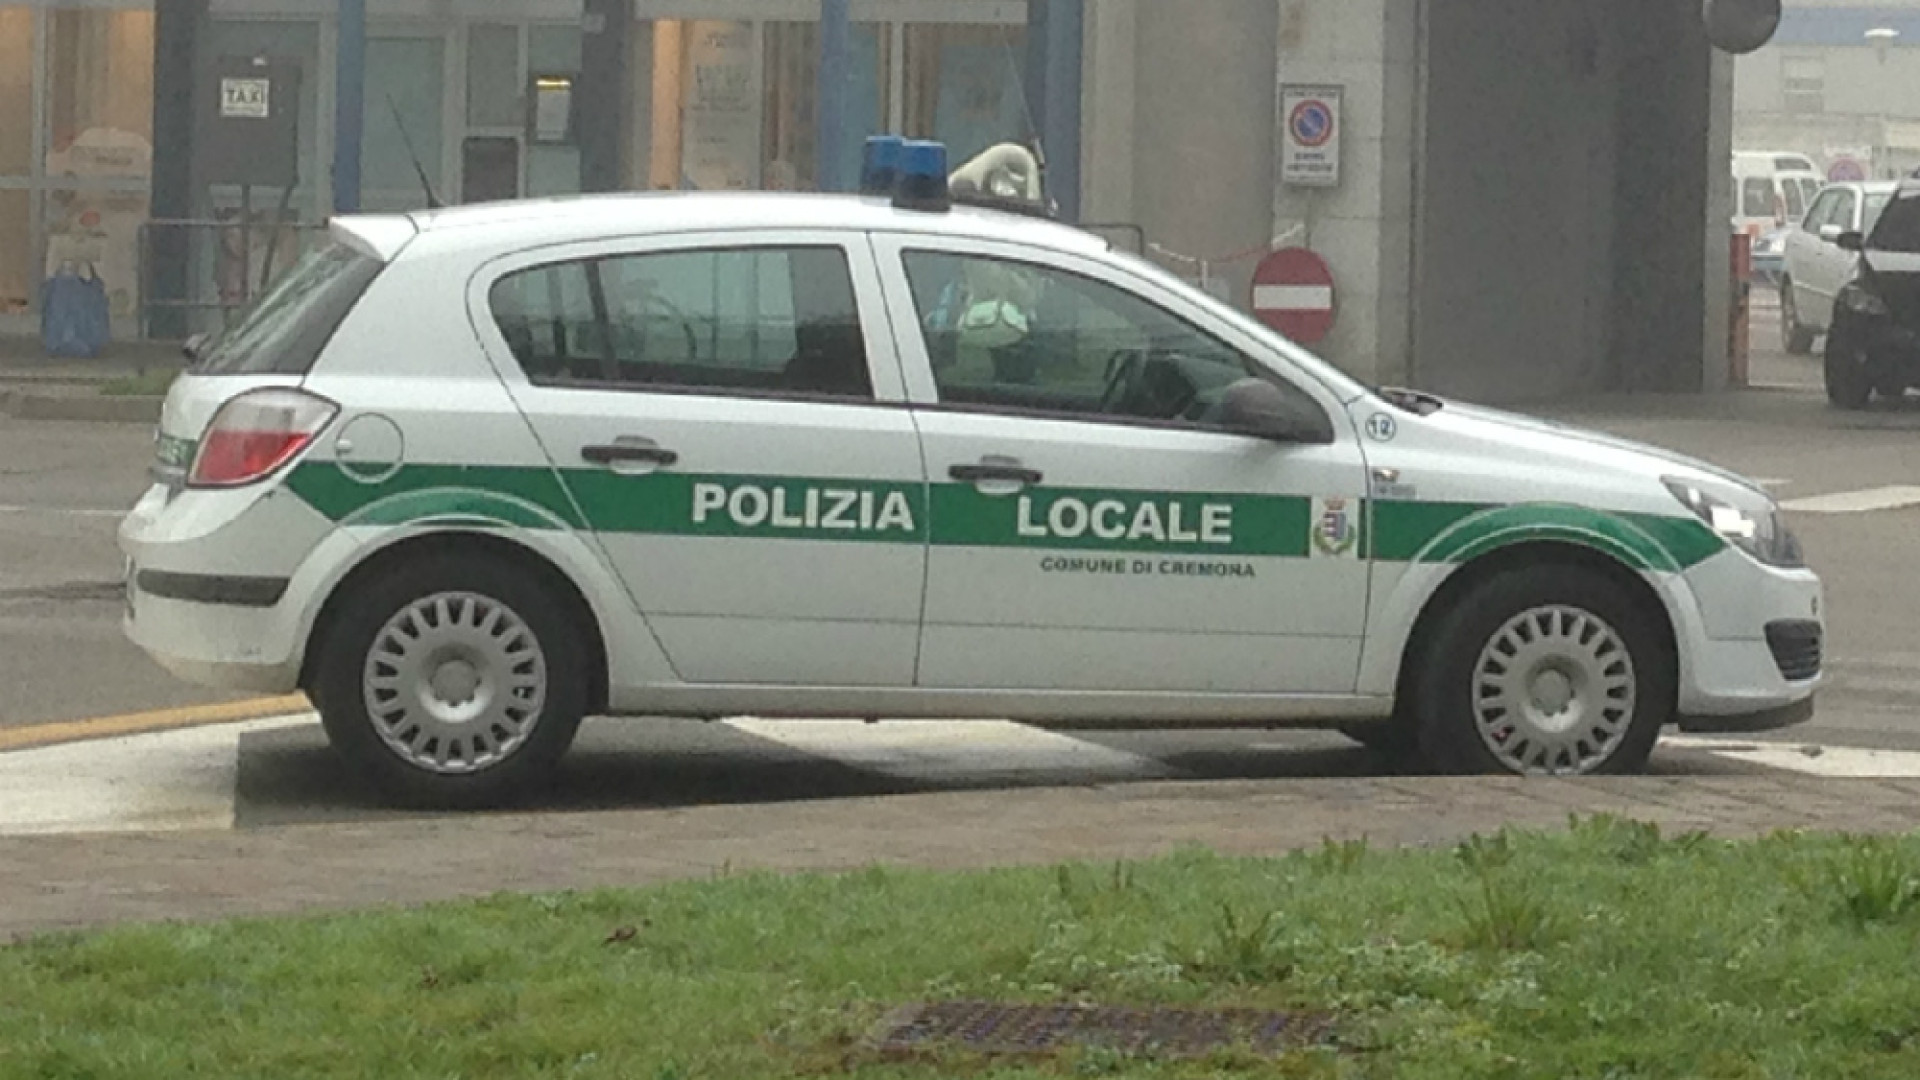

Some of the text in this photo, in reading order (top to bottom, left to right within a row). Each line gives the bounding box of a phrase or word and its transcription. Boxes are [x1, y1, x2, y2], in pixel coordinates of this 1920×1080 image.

[226, 88, 264, 104] TAXI
[1368, 418, 1390, 435] 12
[692, 482, 1233, 544] POLIZIA LOCALE
[1040, 556, 1256, 577] COMUNE DI CREMONA
